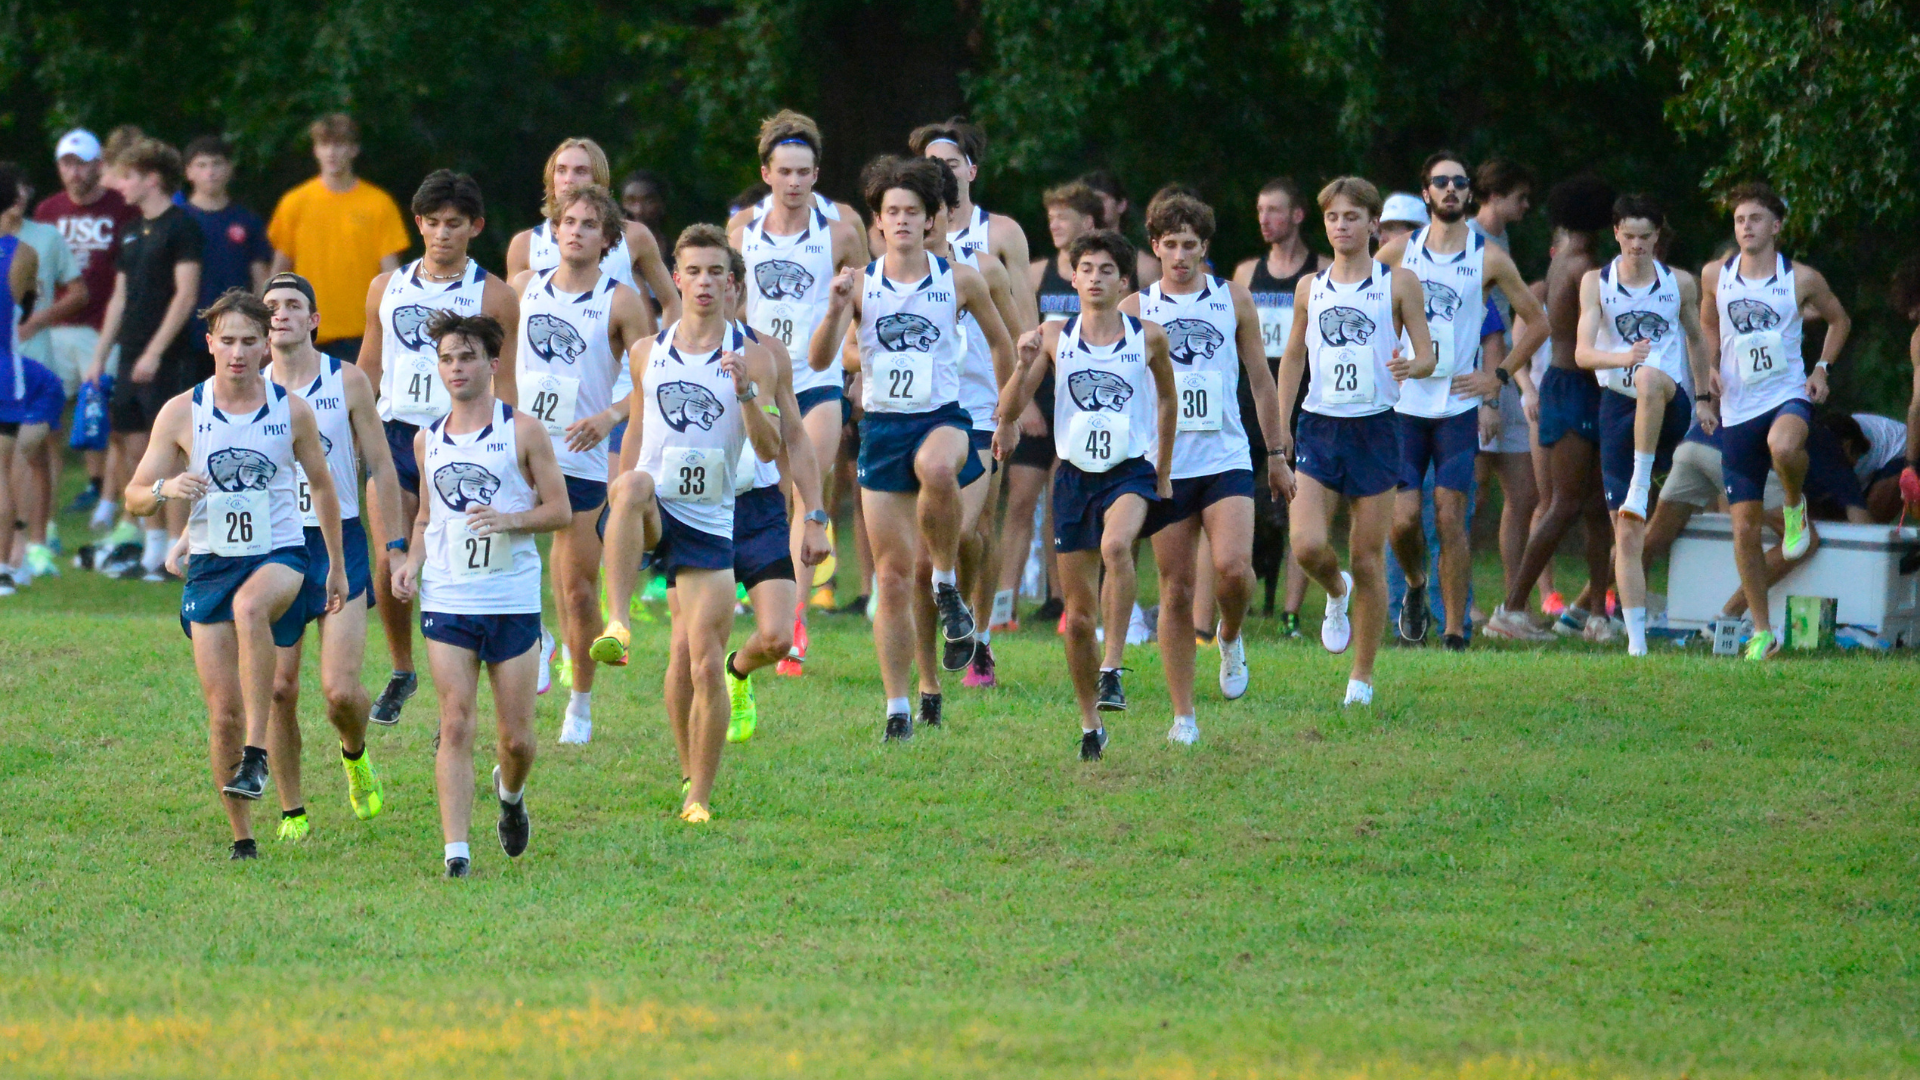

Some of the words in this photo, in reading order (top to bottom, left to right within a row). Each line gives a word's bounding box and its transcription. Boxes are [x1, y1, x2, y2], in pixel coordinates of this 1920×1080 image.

[58, 216, 113, 242] USC
[805, 245, 823, 254] PBC
[1457, 266, 1477, 277] PBC
[927, 292, 950, 302] PBC
[1366, 292, 1383, 300] PBC
[1772, 288, 1788, 296] PBC
[454, 296, 475, 307] PBC
[1209, 302, 1227, 311] PBC
[583, 308, 602, 320] PBC
[771, 318, 793, 347] 28
[1262, 323, 1282, 346] 54
[1121, 354, 1140, 363] PBC
[1750, 346, 1772, 372] 25
[716, 368, 731, 379] PB
[1334, 363, 1357, 391] 23
[408, 373, 432, 403] 41
[889, 369, 914, 398] 22
[315, 397, 339, 410] PBC
[532, 391, 558, 422] 42
[1183, 389, 1207, 418] 30
[263, 423, 287, 436] PBC
[487, 443, 507, 452] PBC
[1085, 430, 1111, 460] 43
[679, 467, 705, 495] 33
[226, 512, 253, 543] 26
[466, 537, 491, 569] 27
[1722, 626, 1735, 636] BOX
